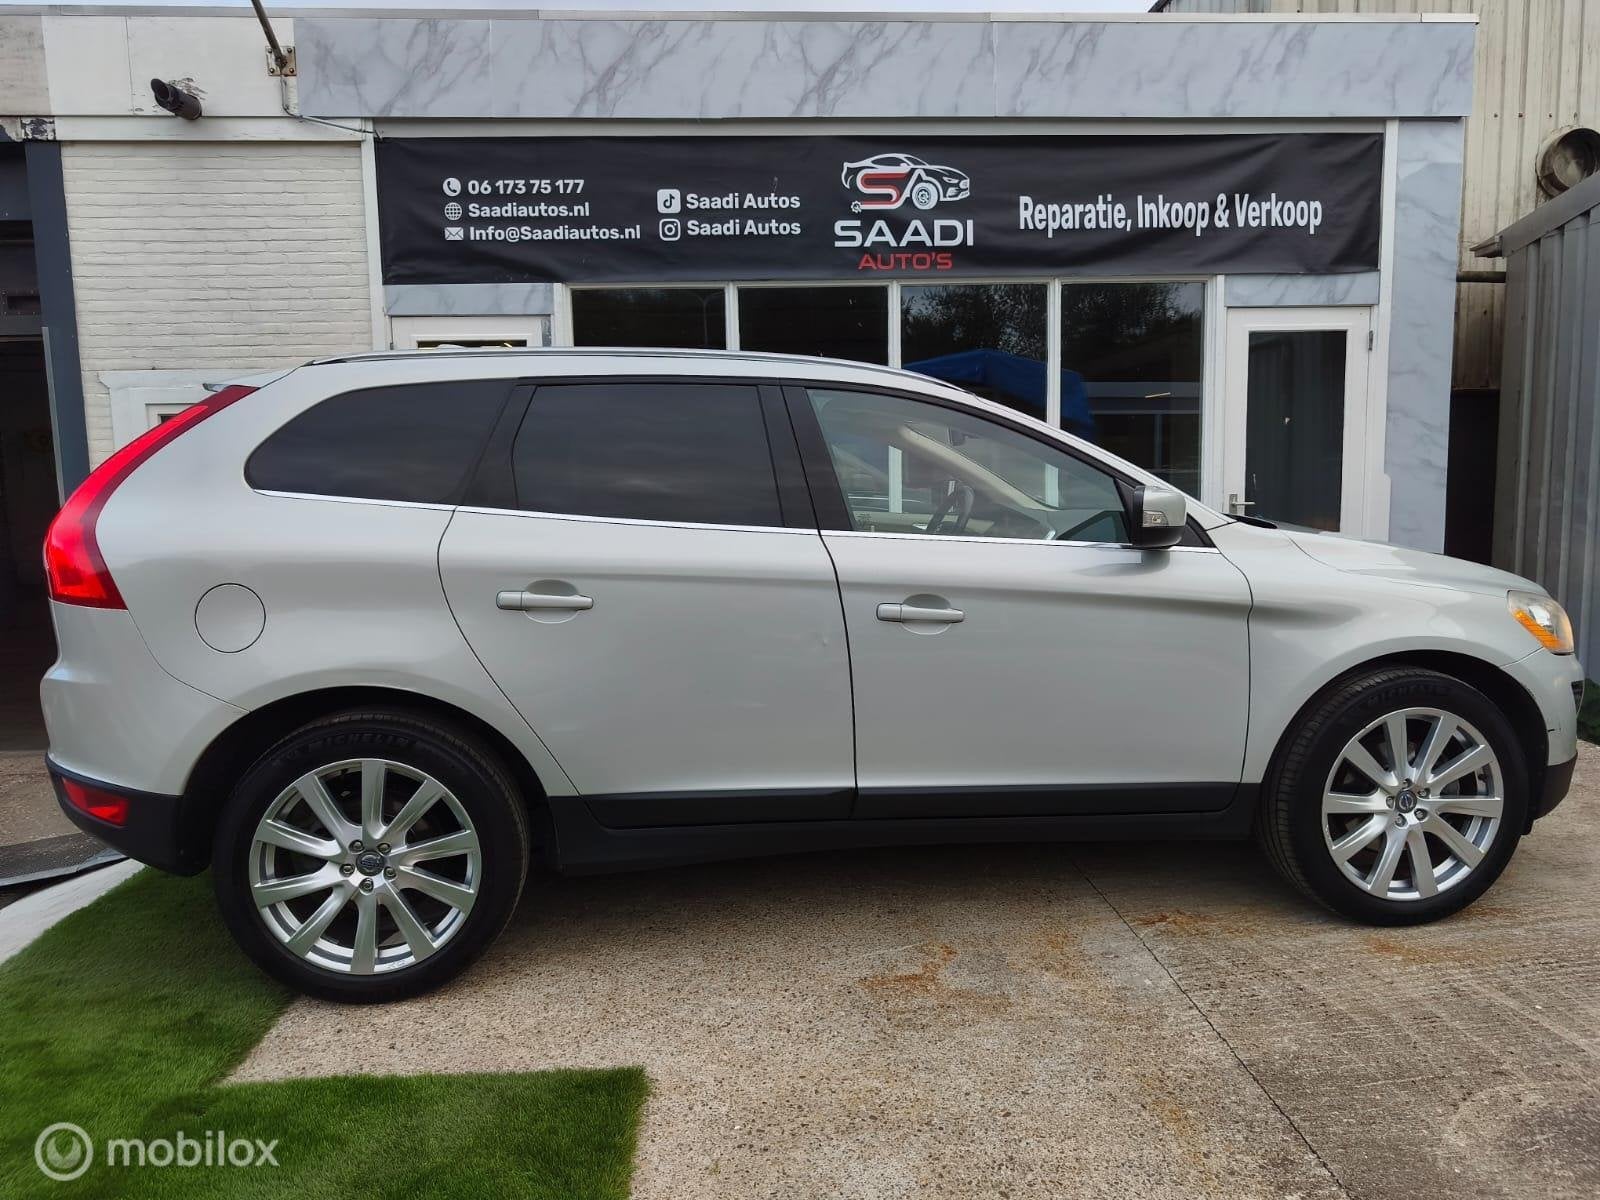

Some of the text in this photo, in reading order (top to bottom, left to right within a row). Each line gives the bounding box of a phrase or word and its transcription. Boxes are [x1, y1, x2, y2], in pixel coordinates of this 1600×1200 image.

[467, 179, 585, 195] 06 173 75 177
[468, 201, 590, 218] Saadiautos.nl
[686, 192, 801, 210] Saadi Autos
[1019, 192, 1323, 238] Reparatie, Inkoop & Verkoop
[469, 224, 641, 243] Info@Saadiautos.nl
[686, 218, 802, 236] Saadi Autos
[834, 219, 974, 248] SAADI
[858, 253, 953, 271] AUTO'S
